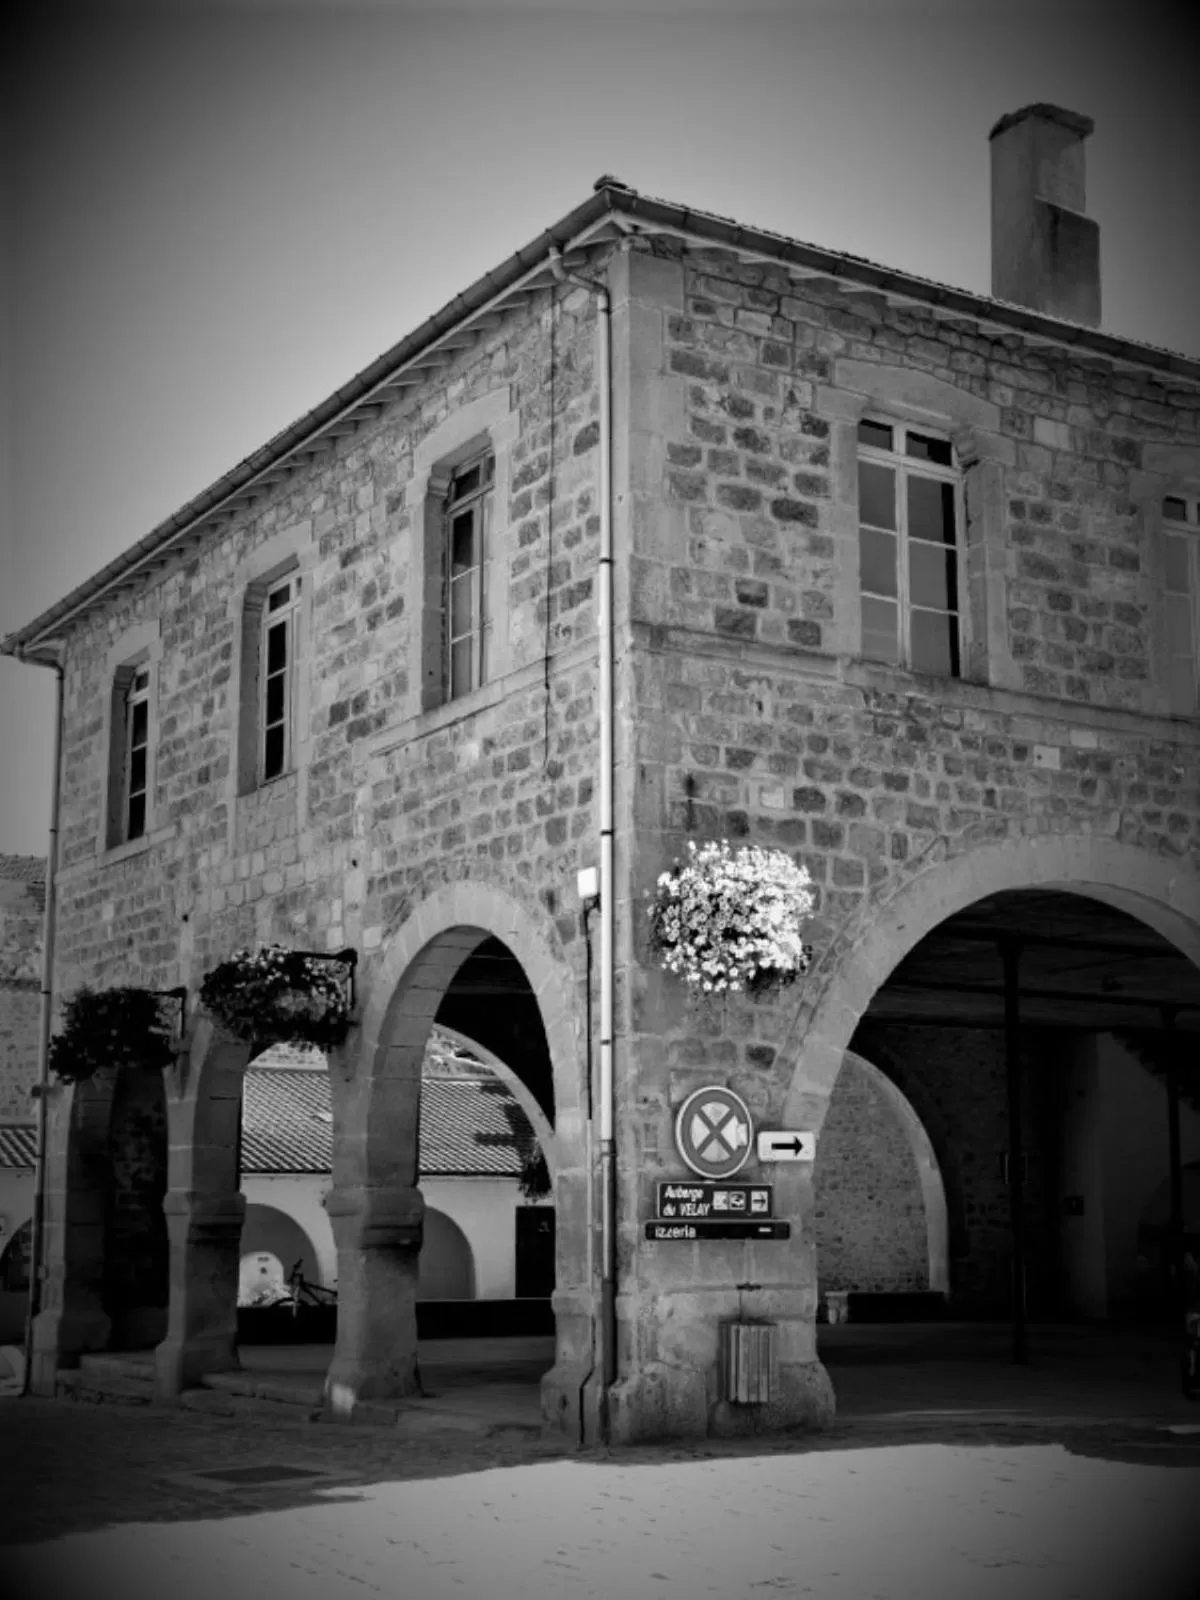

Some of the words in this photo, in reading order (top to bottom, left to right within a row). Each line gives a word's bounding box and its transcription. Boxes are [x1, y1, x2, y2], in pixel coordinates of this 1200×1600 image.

[664, 1185, 704, 1201] Auberge
[663, 1203, 676, 1216] du
[680, 1203, 710, 1216] VELAY
